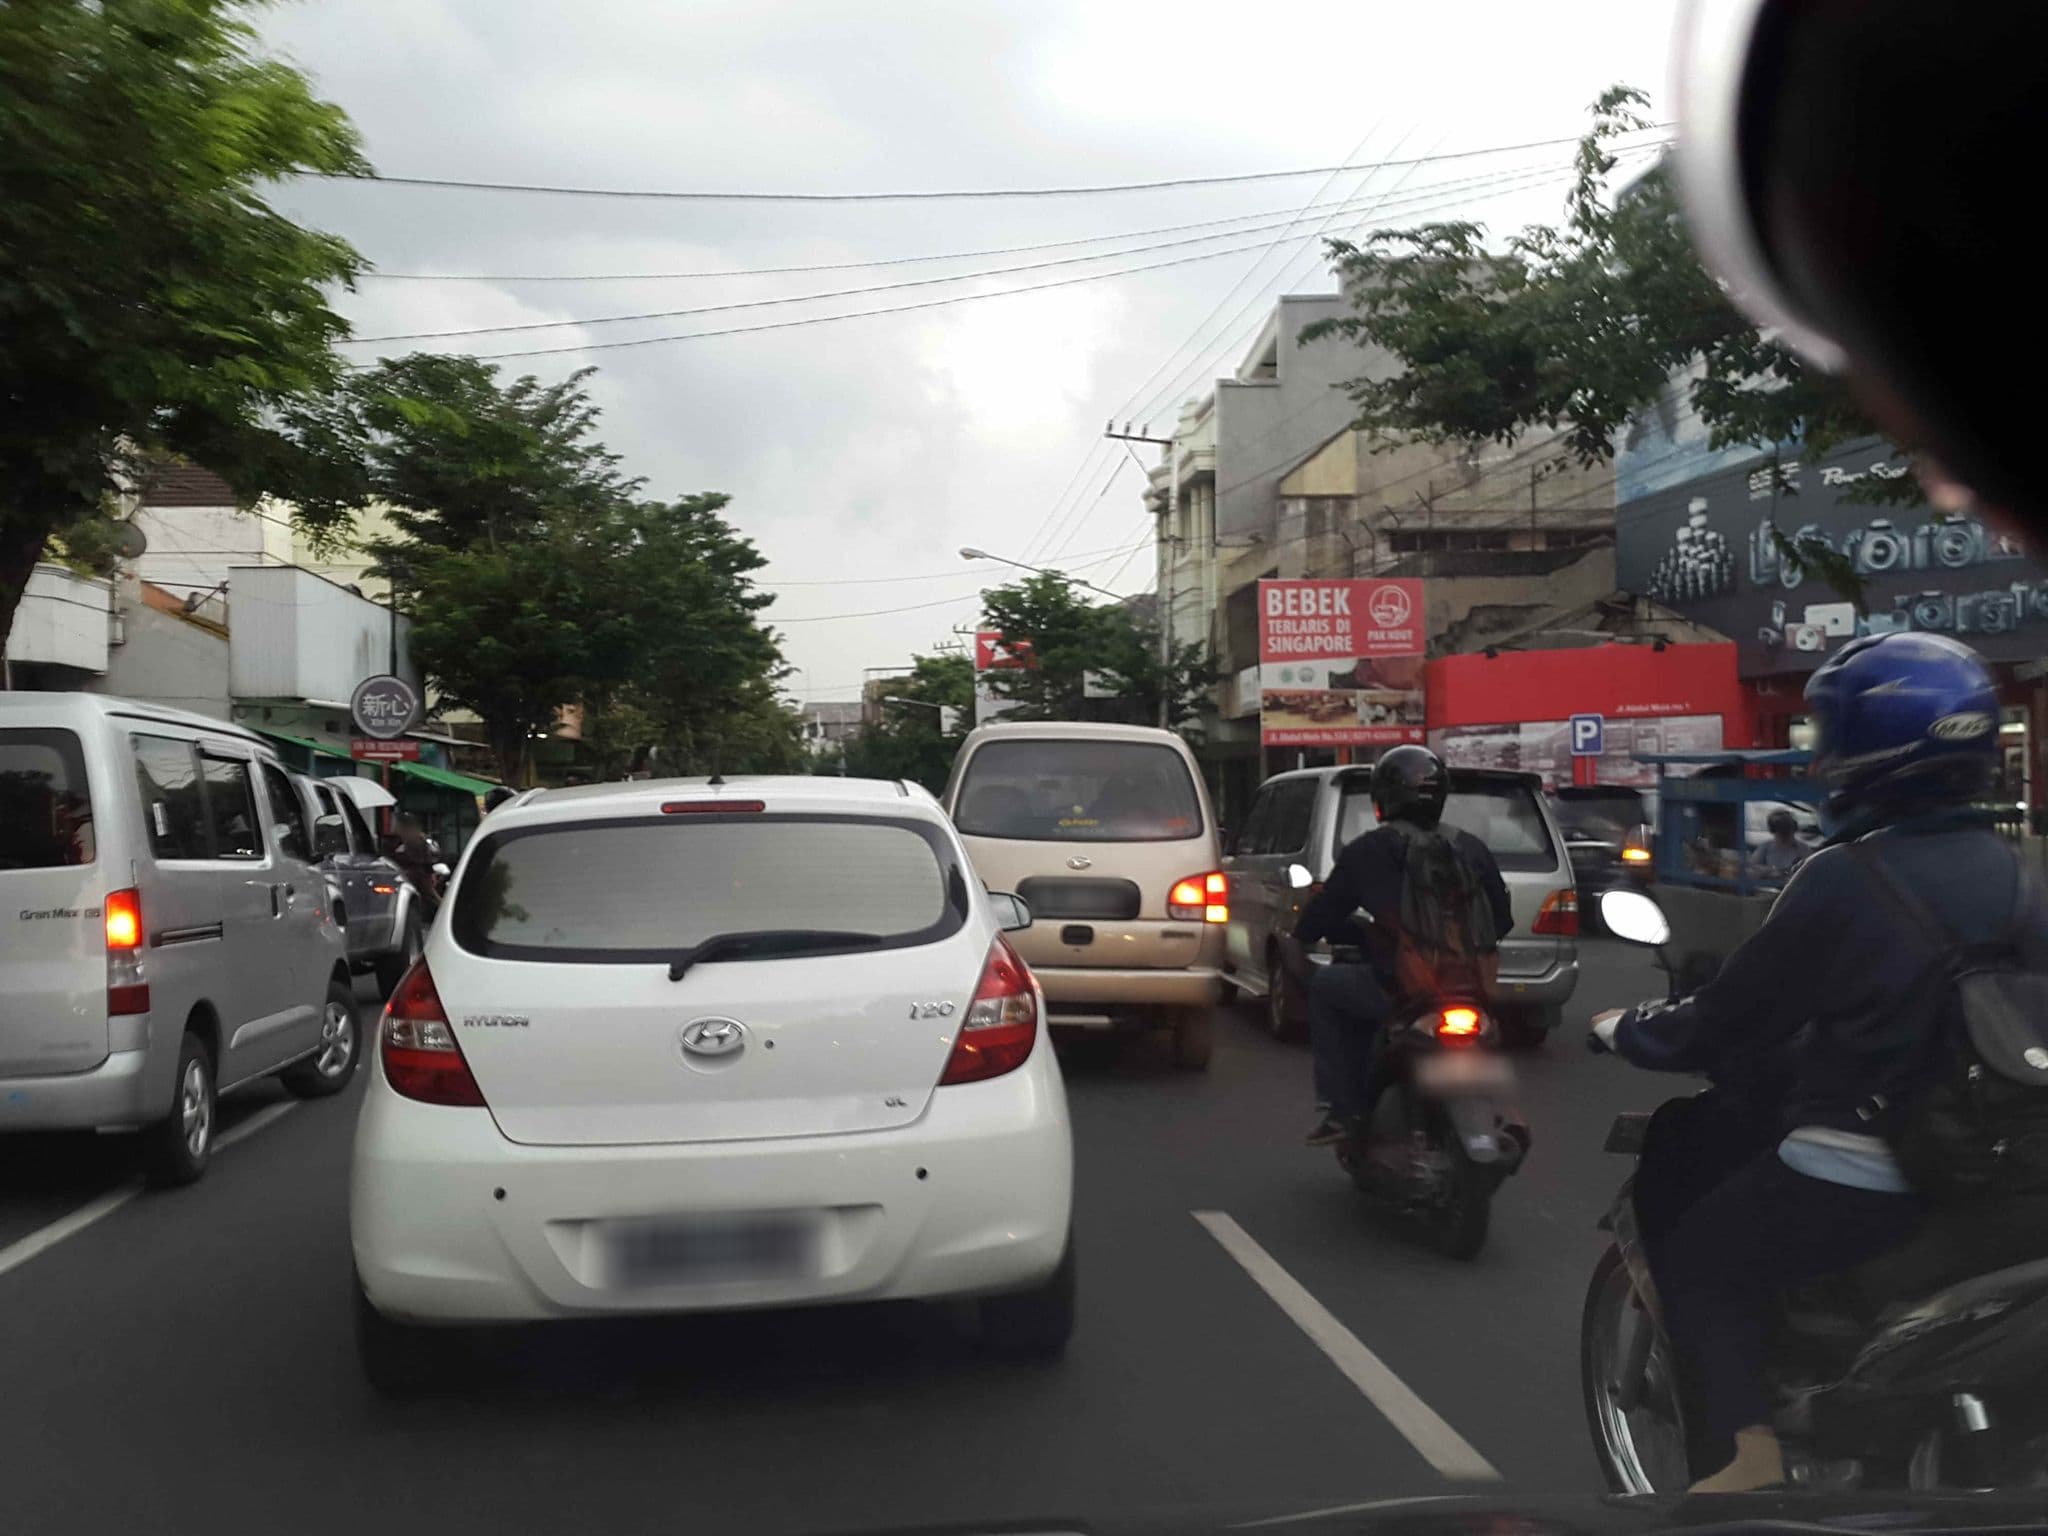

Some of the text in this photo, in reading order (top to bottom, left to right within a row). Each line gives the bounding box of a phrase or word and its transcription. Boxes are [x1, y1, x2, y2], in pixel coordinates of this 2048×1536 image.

[1266, 587, 1352, 617] BEBEK
[1267, 619, 1350, 634] TERLARIS DI
[1267, 635, 1353, 653] SINGAPORE
[362, 693, 410, 717] 新心
[1576, 720, 1598, 749] P
[20, 910, 51, 920] Gran
[53, 908, 78, 918] Max
[463, 1015, 529, 1027] HYUNDAI
